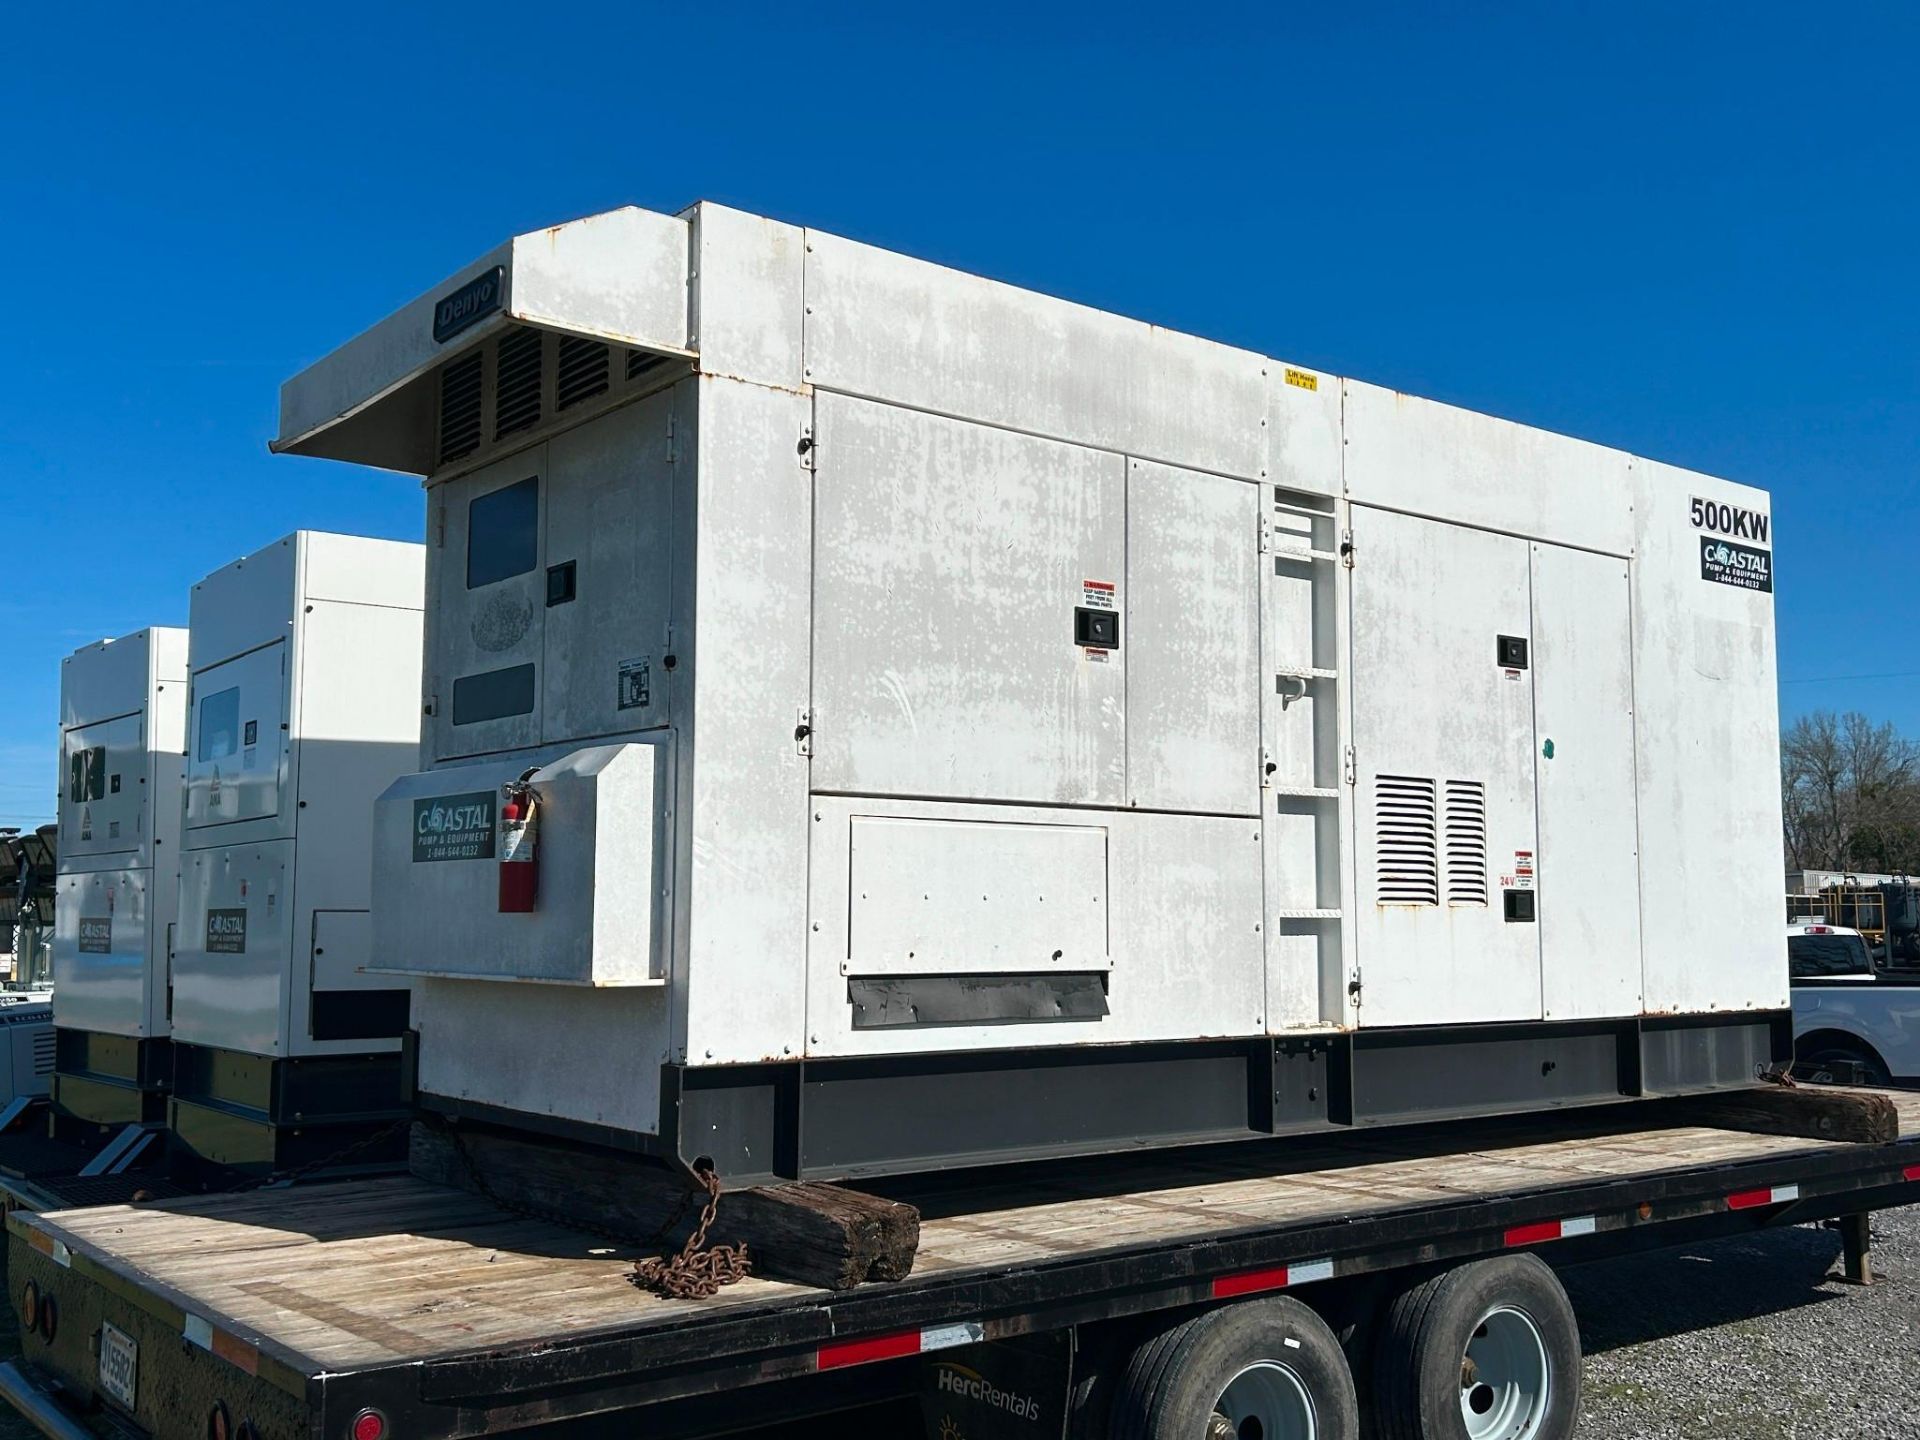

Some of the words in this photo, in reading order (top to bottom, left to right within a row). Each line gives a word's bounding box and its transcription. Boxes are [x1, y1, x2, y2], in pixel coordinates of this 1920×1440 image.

[439, 283, 492, 327] Denyo
[1691, 498, 1768, 542] 500KW
[1705, 562, 1724, 572] PUMP
[1732, 568, 1768, 581] EQUIPMENT
[1715, 573, 1760, 589] 1-844-644-0132
[418, 836, 438, 846] PUMP
[447, 832, 490, 844] EQUIPMENT
[427, 845, 479, 858] 1-844-644-0132
[1500, 876, 1515, 886] 24V
[938, 1369, 1040, 1421] HercRentals
